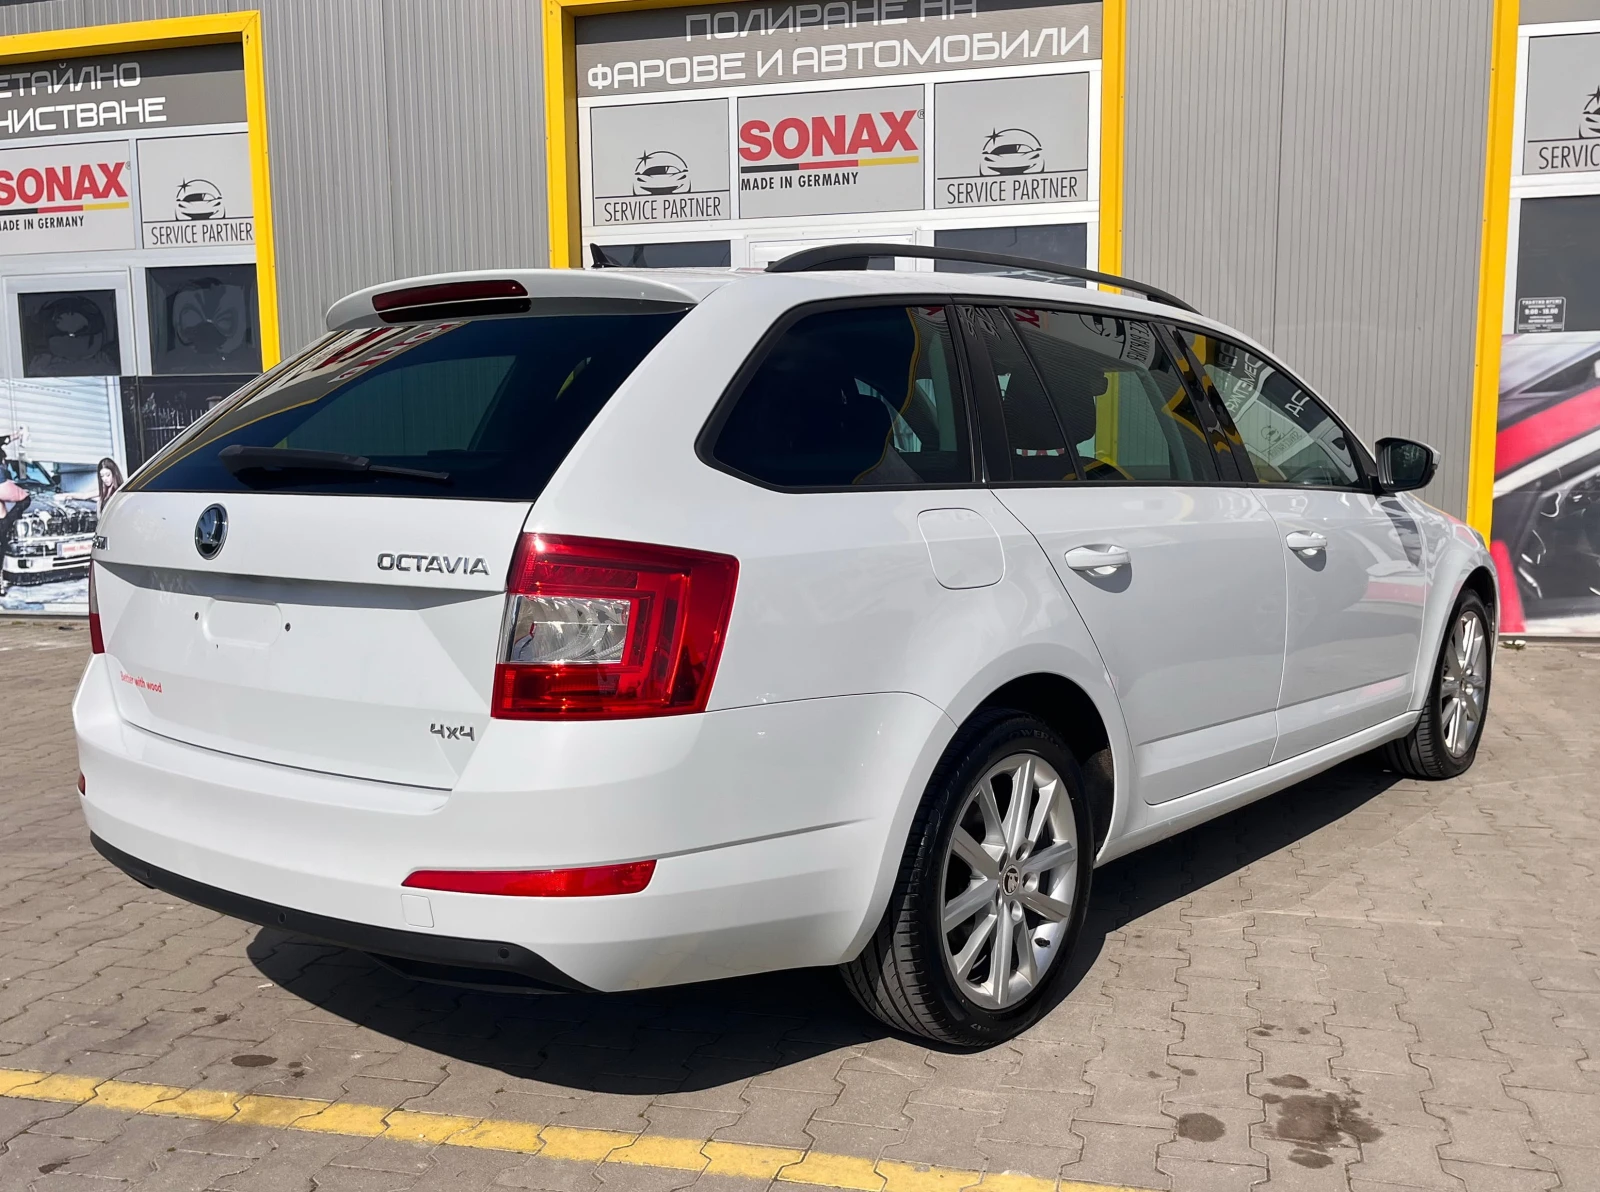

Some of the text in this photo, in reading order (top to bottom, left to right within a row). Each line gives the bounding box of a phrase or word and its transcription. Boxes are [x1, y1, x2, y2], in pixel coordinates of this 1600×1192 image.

[686, 0, 908, 42] ПОЛИРАНЕ
[587, 25, 1090, 90] ФАРОВЕ И АВТОМОБИЛИ
[739, 110, 918, 161] SONAX
[0, 162, 128, 206] SONAX
[741, 172, 859, 191] MADE IN GERMANY
[947, 177, 1077, 204] SERVICE PARTNER
[604, 196, 721, 222] SERVICE PARTNER
[0, 215, 84, 231] ADE IN GERMANY
[151, 222, 253, 245] SERVICE PARTNER
[377, 553, 490, 576] OCTAVIA
